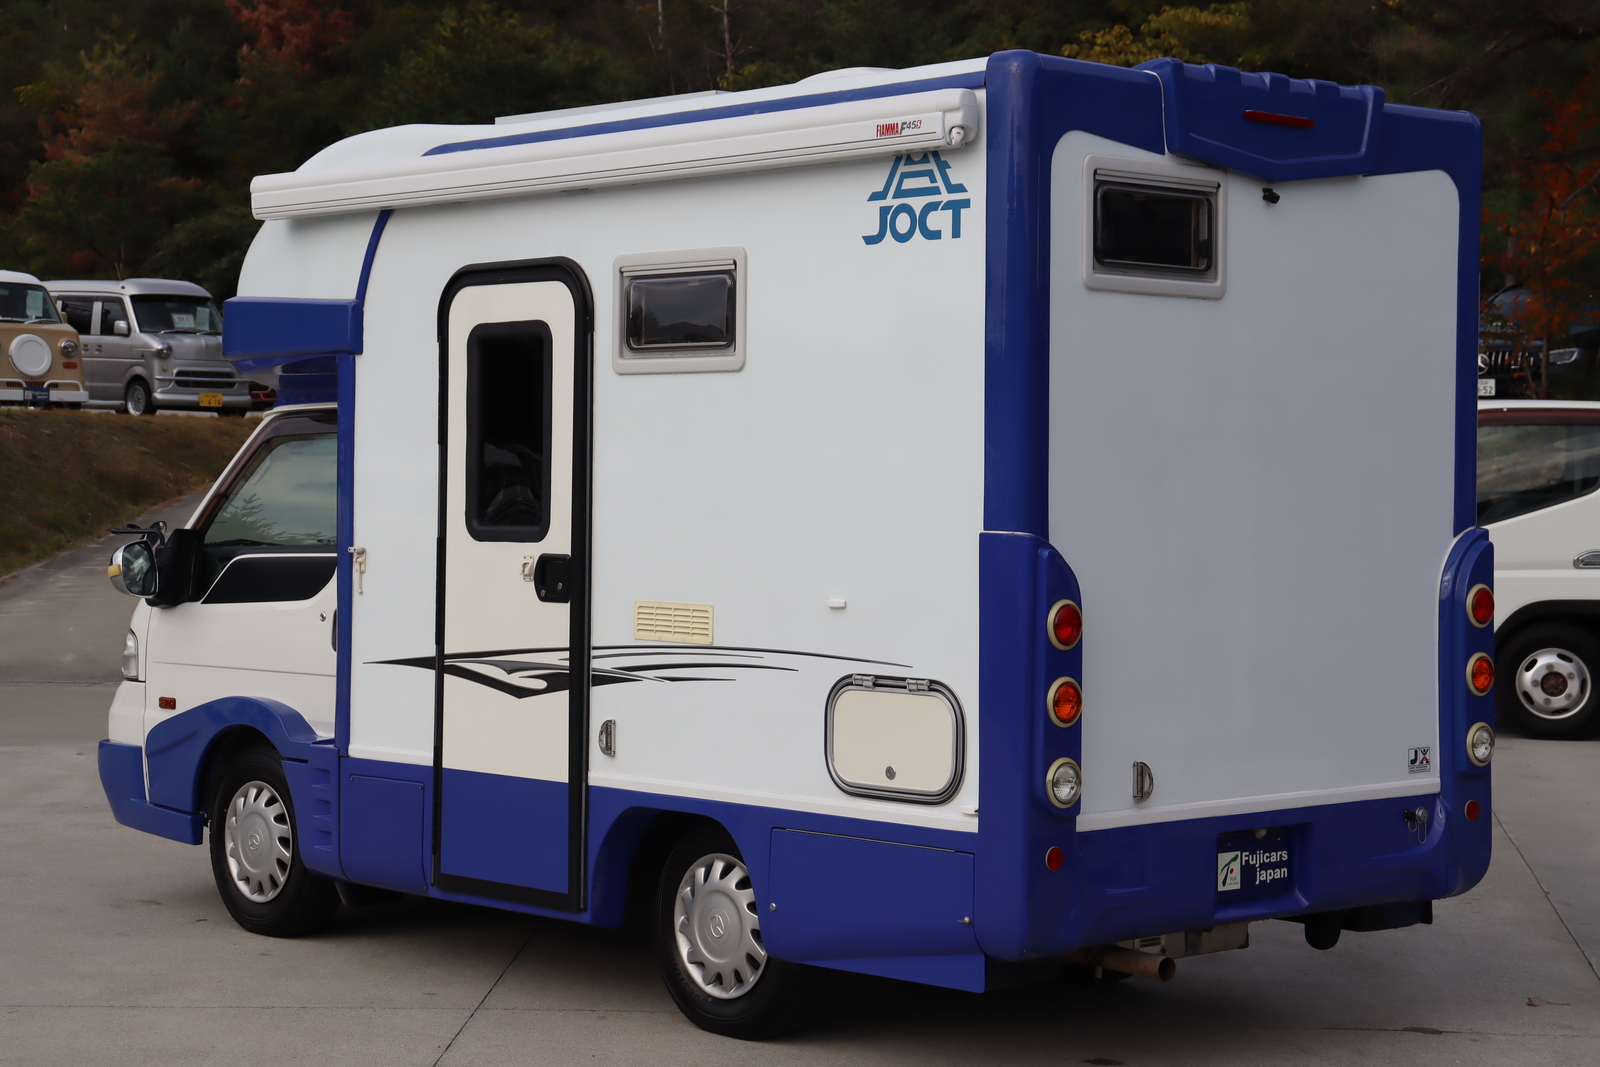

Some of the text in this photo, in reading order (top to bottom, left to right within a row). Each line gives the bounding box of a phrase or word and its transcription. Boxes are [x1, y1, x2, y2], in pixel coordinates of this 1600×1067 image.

[876, 122, 899, 137] FIAMMA
[862, 198, 971, 245] JOCT
[1242, 850, 1288, 867] Fujicars
[1255, 868, 1288, 885] japan
